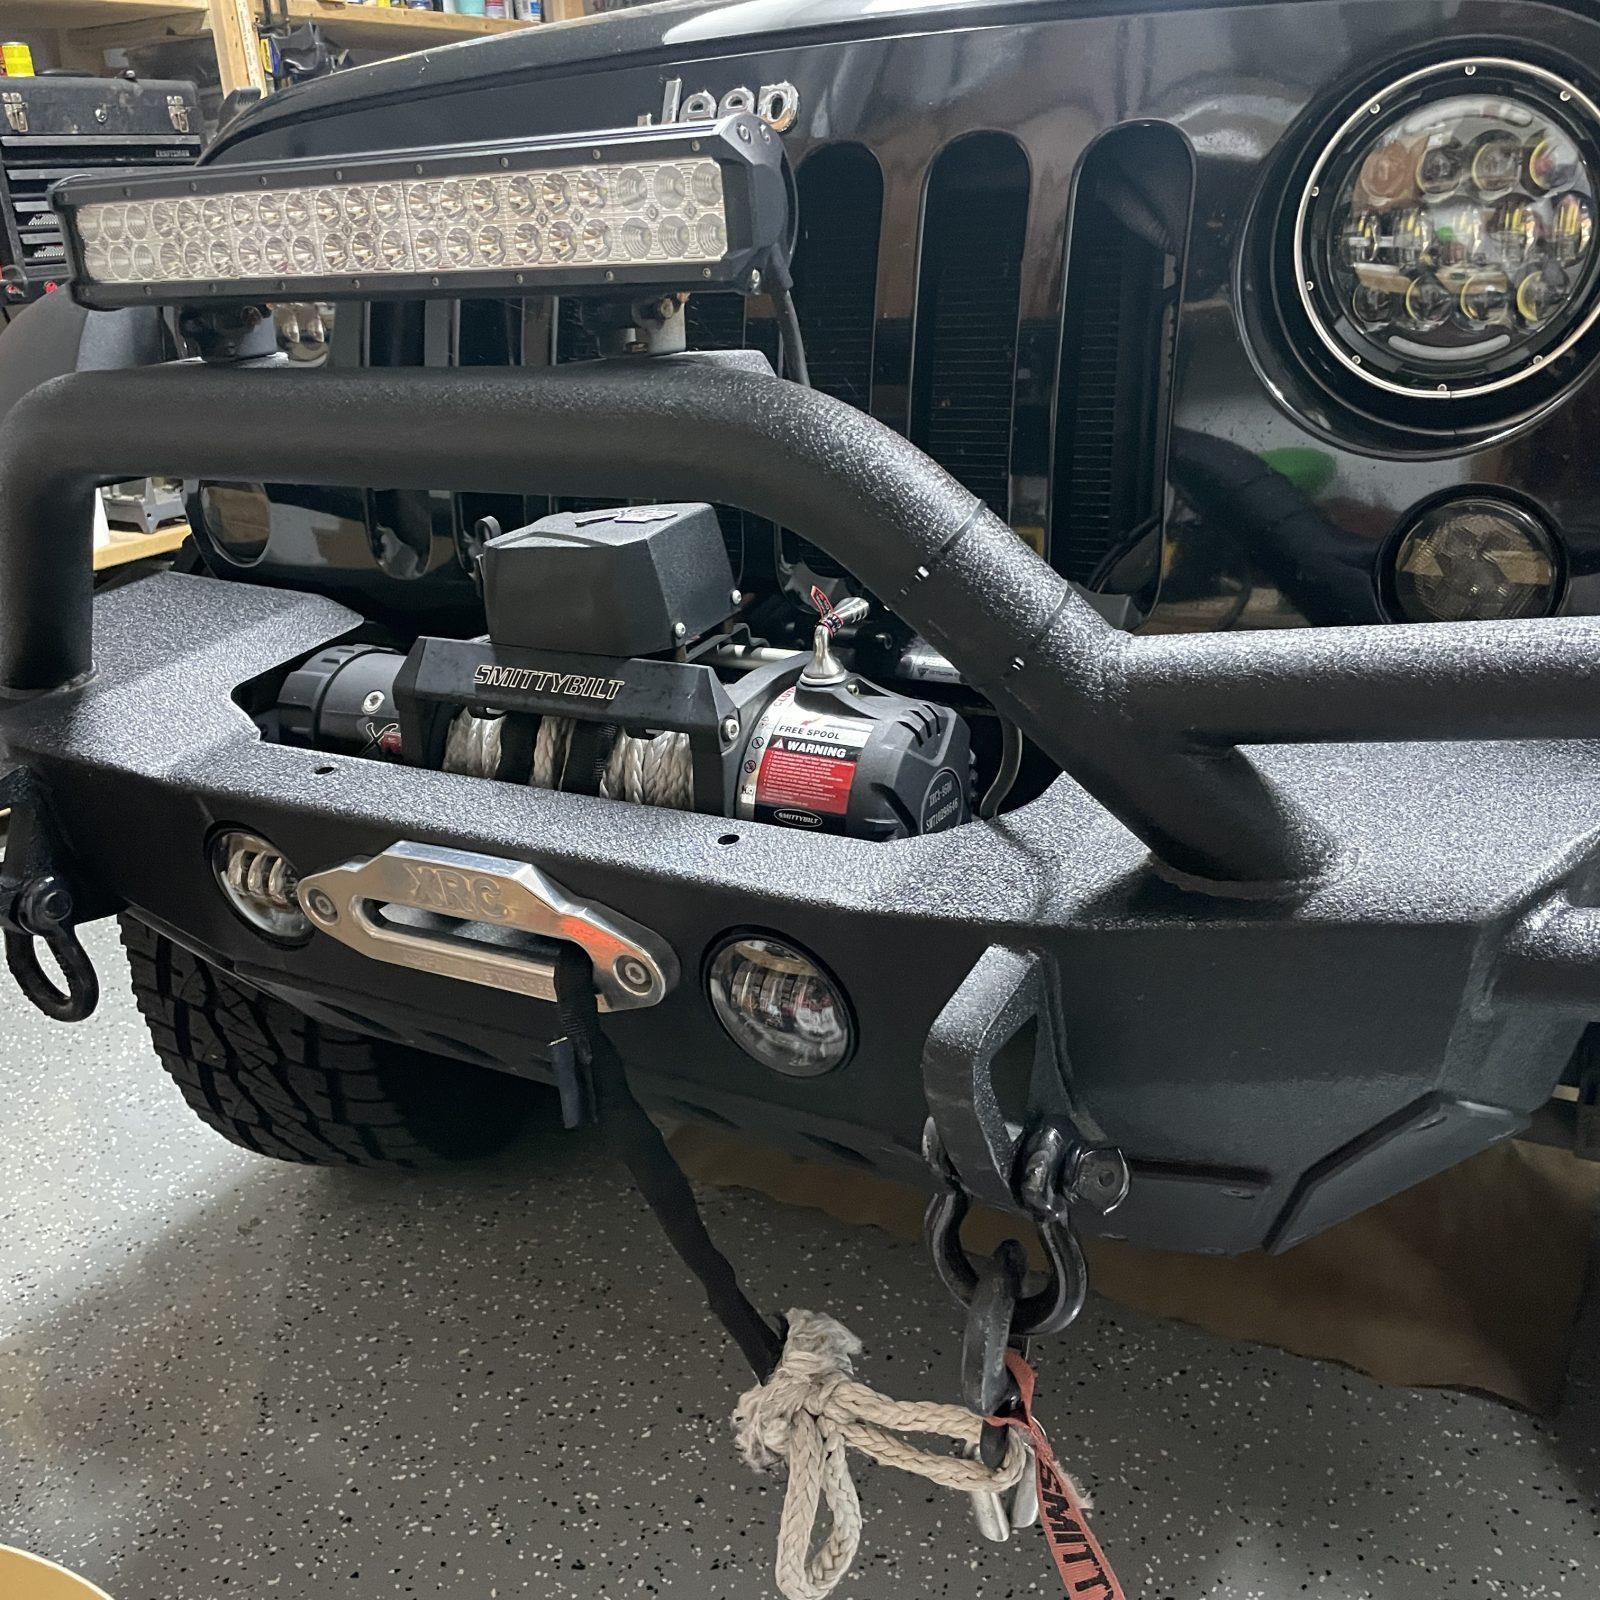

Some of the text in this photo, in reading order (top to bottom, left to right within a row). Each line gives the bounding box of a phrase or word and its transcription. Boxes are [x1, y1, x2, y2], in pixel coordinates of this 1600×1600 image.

[473, 664, 625, 700] SMITTYBILT
[778, 725, 841, 740] FREE SPOOL
[786, 740, 847, 759] WARNING
